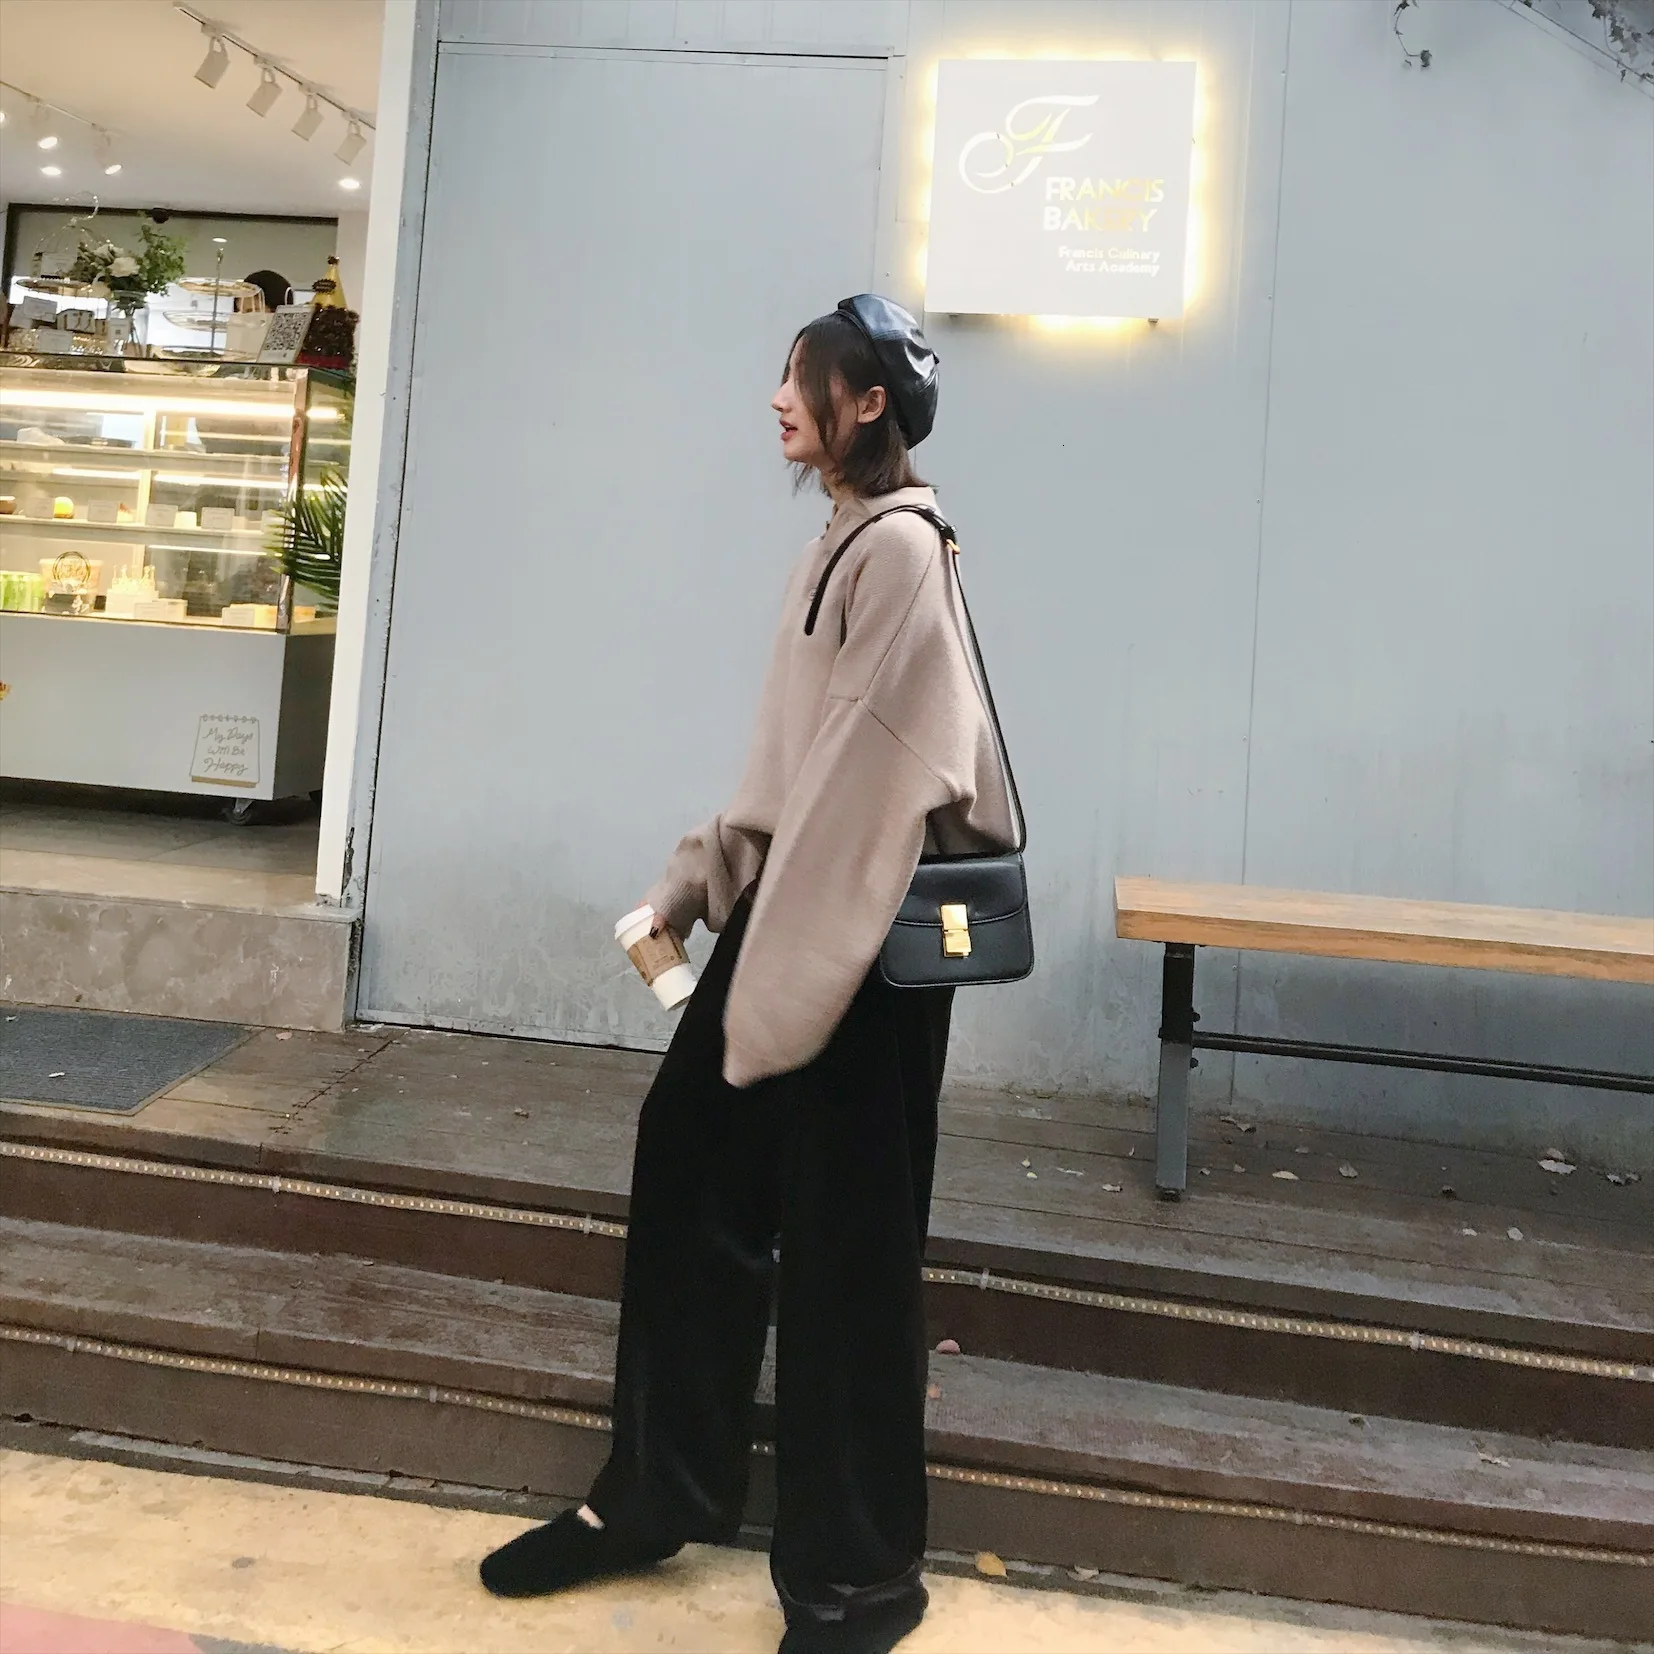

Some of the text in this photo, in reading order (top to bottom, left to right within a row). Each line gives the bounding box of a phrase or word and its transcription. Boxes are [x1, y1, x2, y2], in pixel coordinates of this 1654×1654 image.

[1045, 176, 1165, 203] FRANCIS
[1042, 205, 1158, 233] BAKERY
[1058, 245, 1160, 264] Francis Culinary
[1065, 260, 1160, 277] Arts Academy
[202, 727, 225, 744] My
[203, 757, 249, 776] Happy
